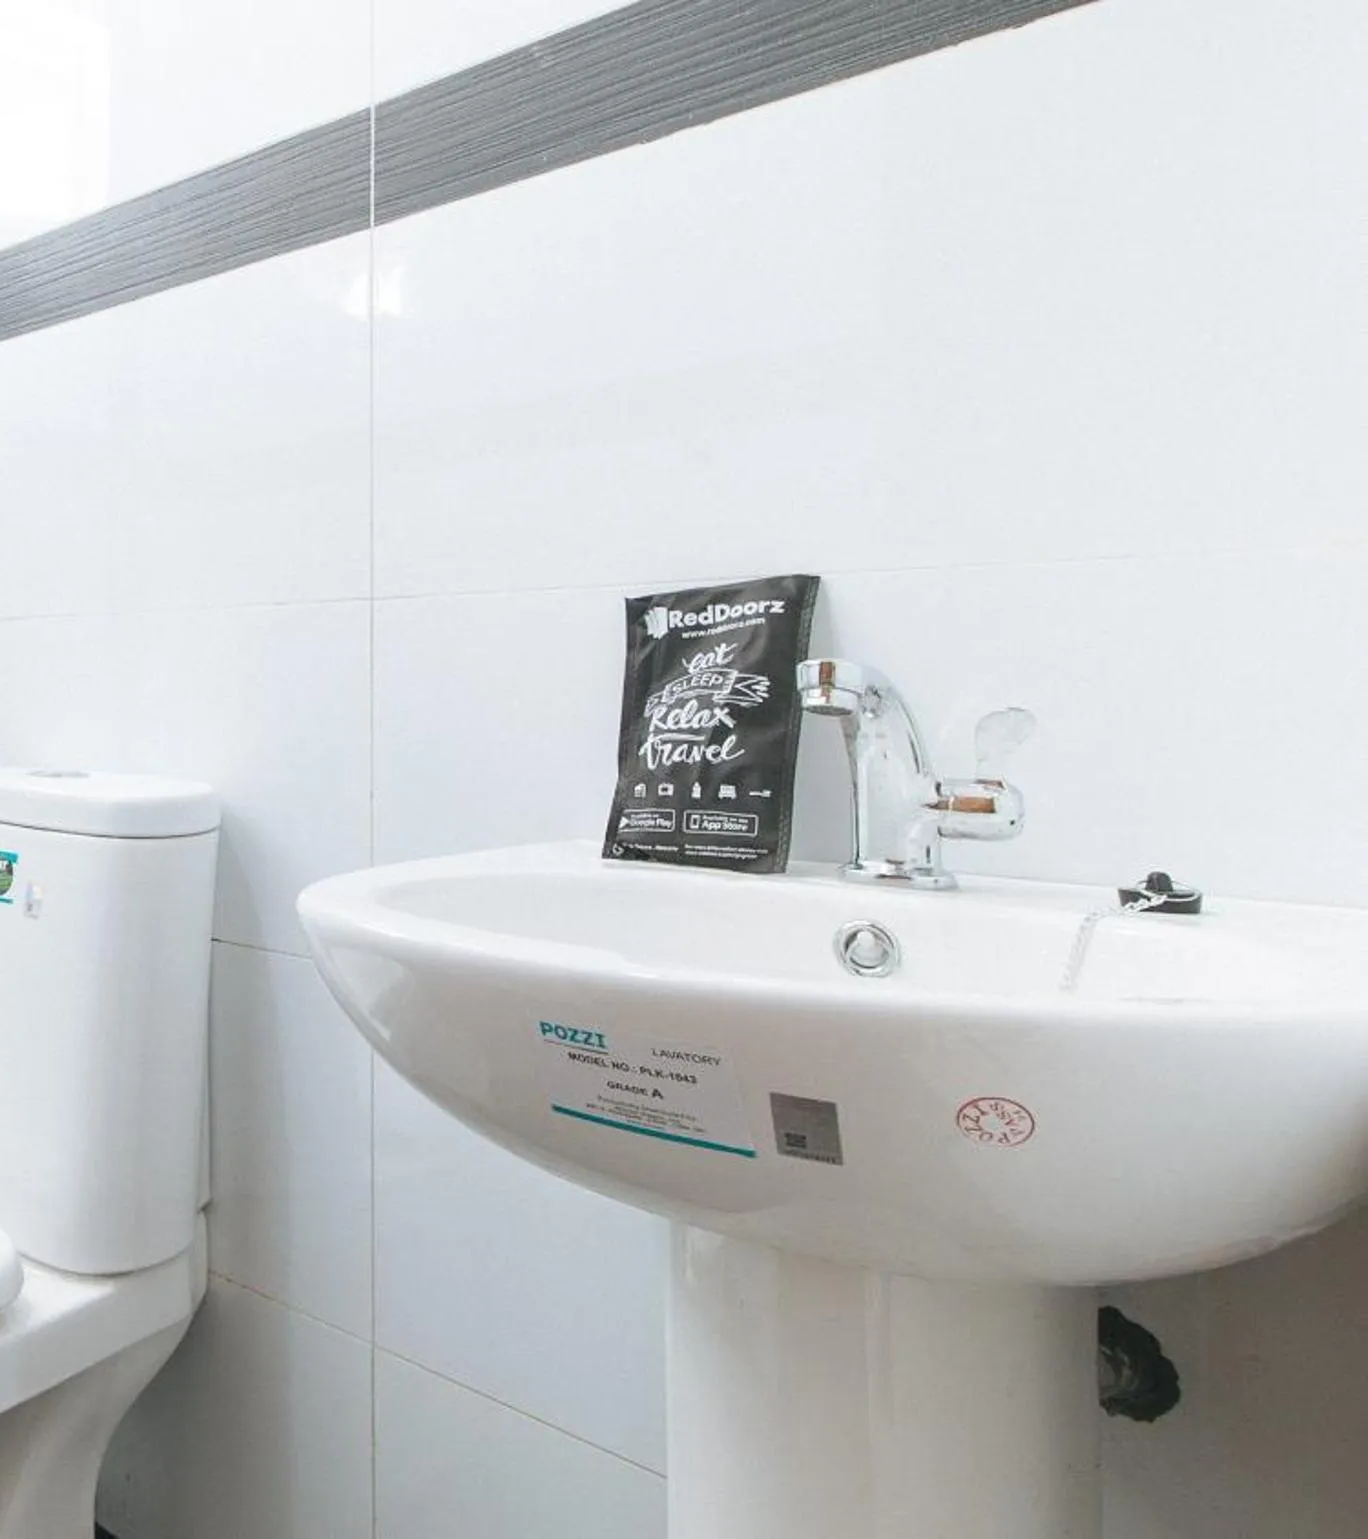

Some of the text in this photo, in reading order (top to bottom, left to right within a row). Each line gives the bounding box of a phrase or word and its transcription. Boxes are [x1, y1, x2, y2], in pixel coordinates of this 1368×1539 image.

[669, 600, 785, 629] RedDoorz
[672, 673, 724, 693] SLEEP
[701, 820, 749, 832] App Store
[539, 1021, 608, 1049] POZZI
[568, 1052, 608, 1068] MODEL
[651, 1048, 721, 1066] LAVATORY
[606, 1080, 664, 1100] GRADE A
